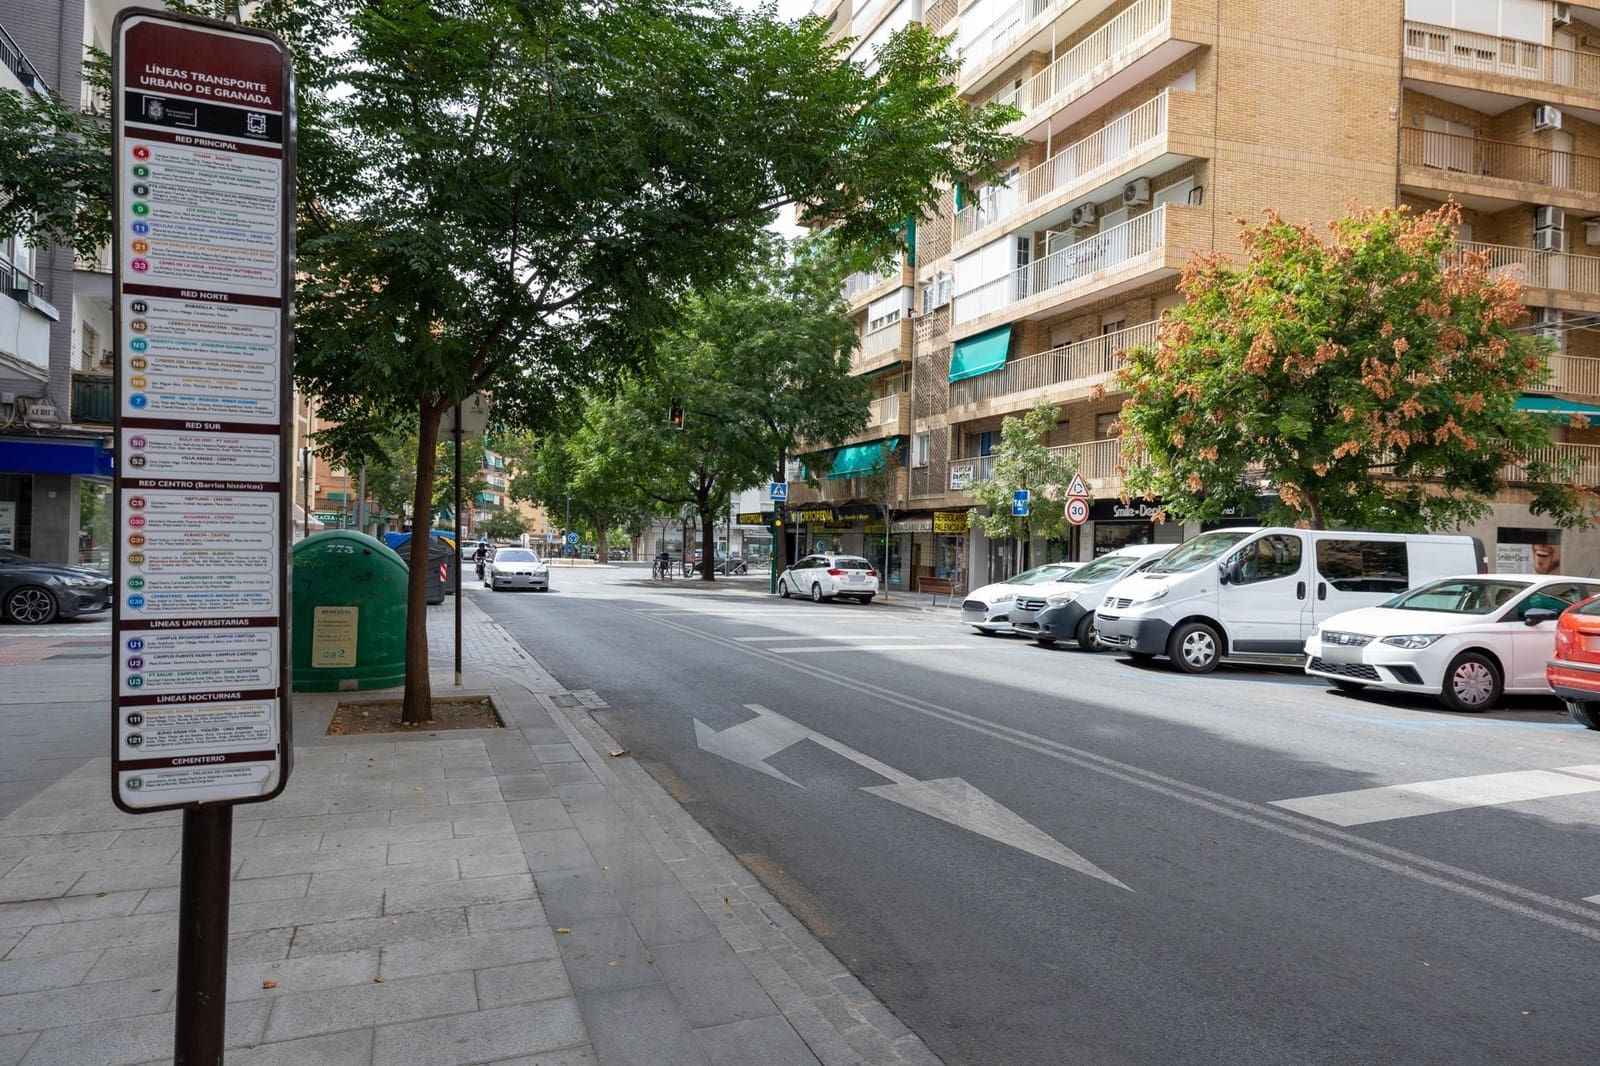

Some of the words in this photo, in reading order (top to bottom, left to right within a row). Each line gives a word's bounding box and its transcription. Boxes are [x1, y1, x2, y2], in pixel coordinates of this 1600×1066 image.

[146, 64, 187, 79] LÍNEAS
[191, 72, 267, 92] TRANSPORTE
[140, 76, 192, 92] URBANO
[196, 85, 211, 95] DE
[215, 88, 272, 105] GRANADA
[175, 135, 192, 144] RED
[194, 138, 237, 150] PRINCIPAL
[200, 292, 228, 300] NORTE
[801, 509, 834, 522] ORTOPEDIA
[1072, 506, 1084, 515] 30
[1113, 504, 1135, 517] Smile
[189, 692, 241, 701] NOCTURNAS
[172, 755, 225, 765] CEMENTERIO
